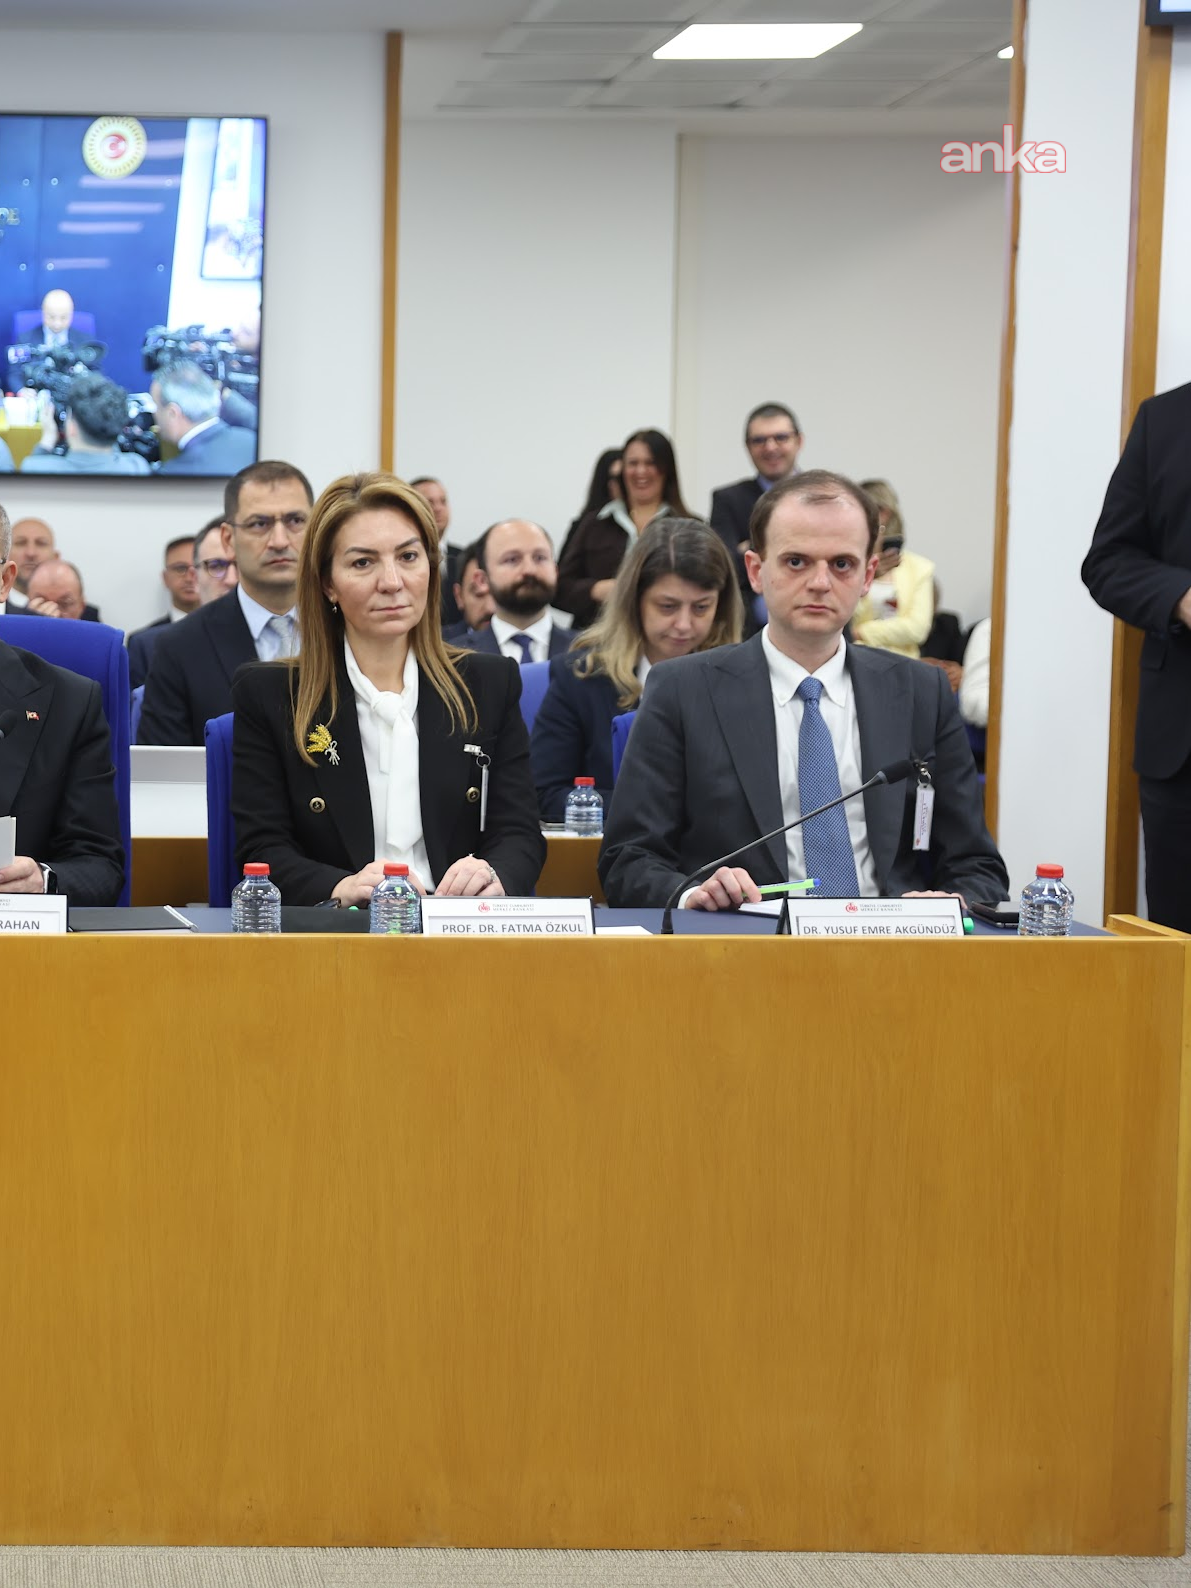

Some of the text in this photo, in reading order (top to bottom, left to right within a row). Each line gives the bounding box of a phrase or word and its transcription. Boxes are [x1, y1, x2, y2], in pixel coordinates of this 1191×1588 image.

[442, 921, 584, 933] PROF. DR. FATMA ÖZKUL
[803, 923, 957, 934] DR. YUSUF EMRE AKGÜNDÜZ
